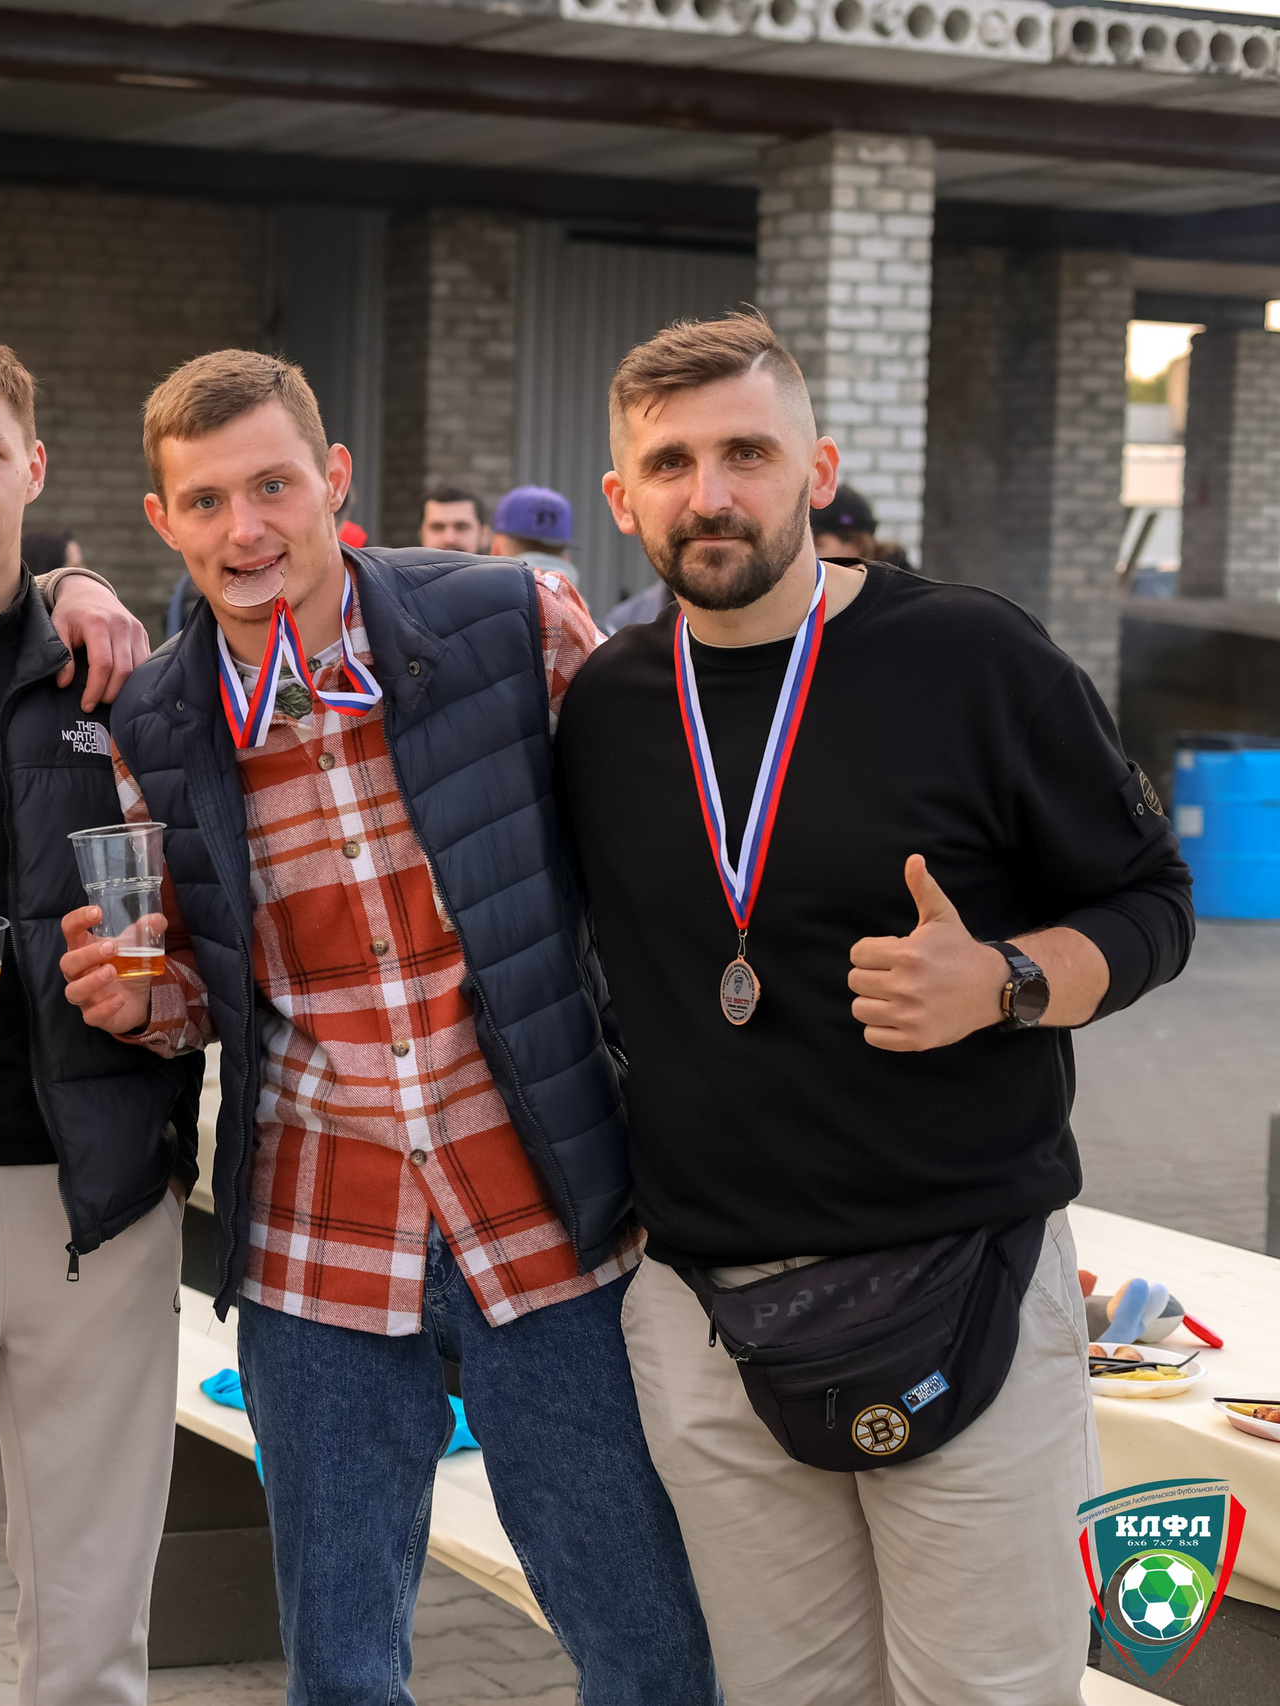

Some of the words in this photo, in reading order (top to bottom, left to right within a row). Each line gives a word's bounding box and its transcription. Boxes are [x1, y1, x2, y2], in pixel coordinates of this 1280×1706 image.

[76, 721, 96, 732] THE
[62, 730, 96, 742] NORTH
[73, 741, 98, 753] FACE
[865, 1416, 895, 1446] B
